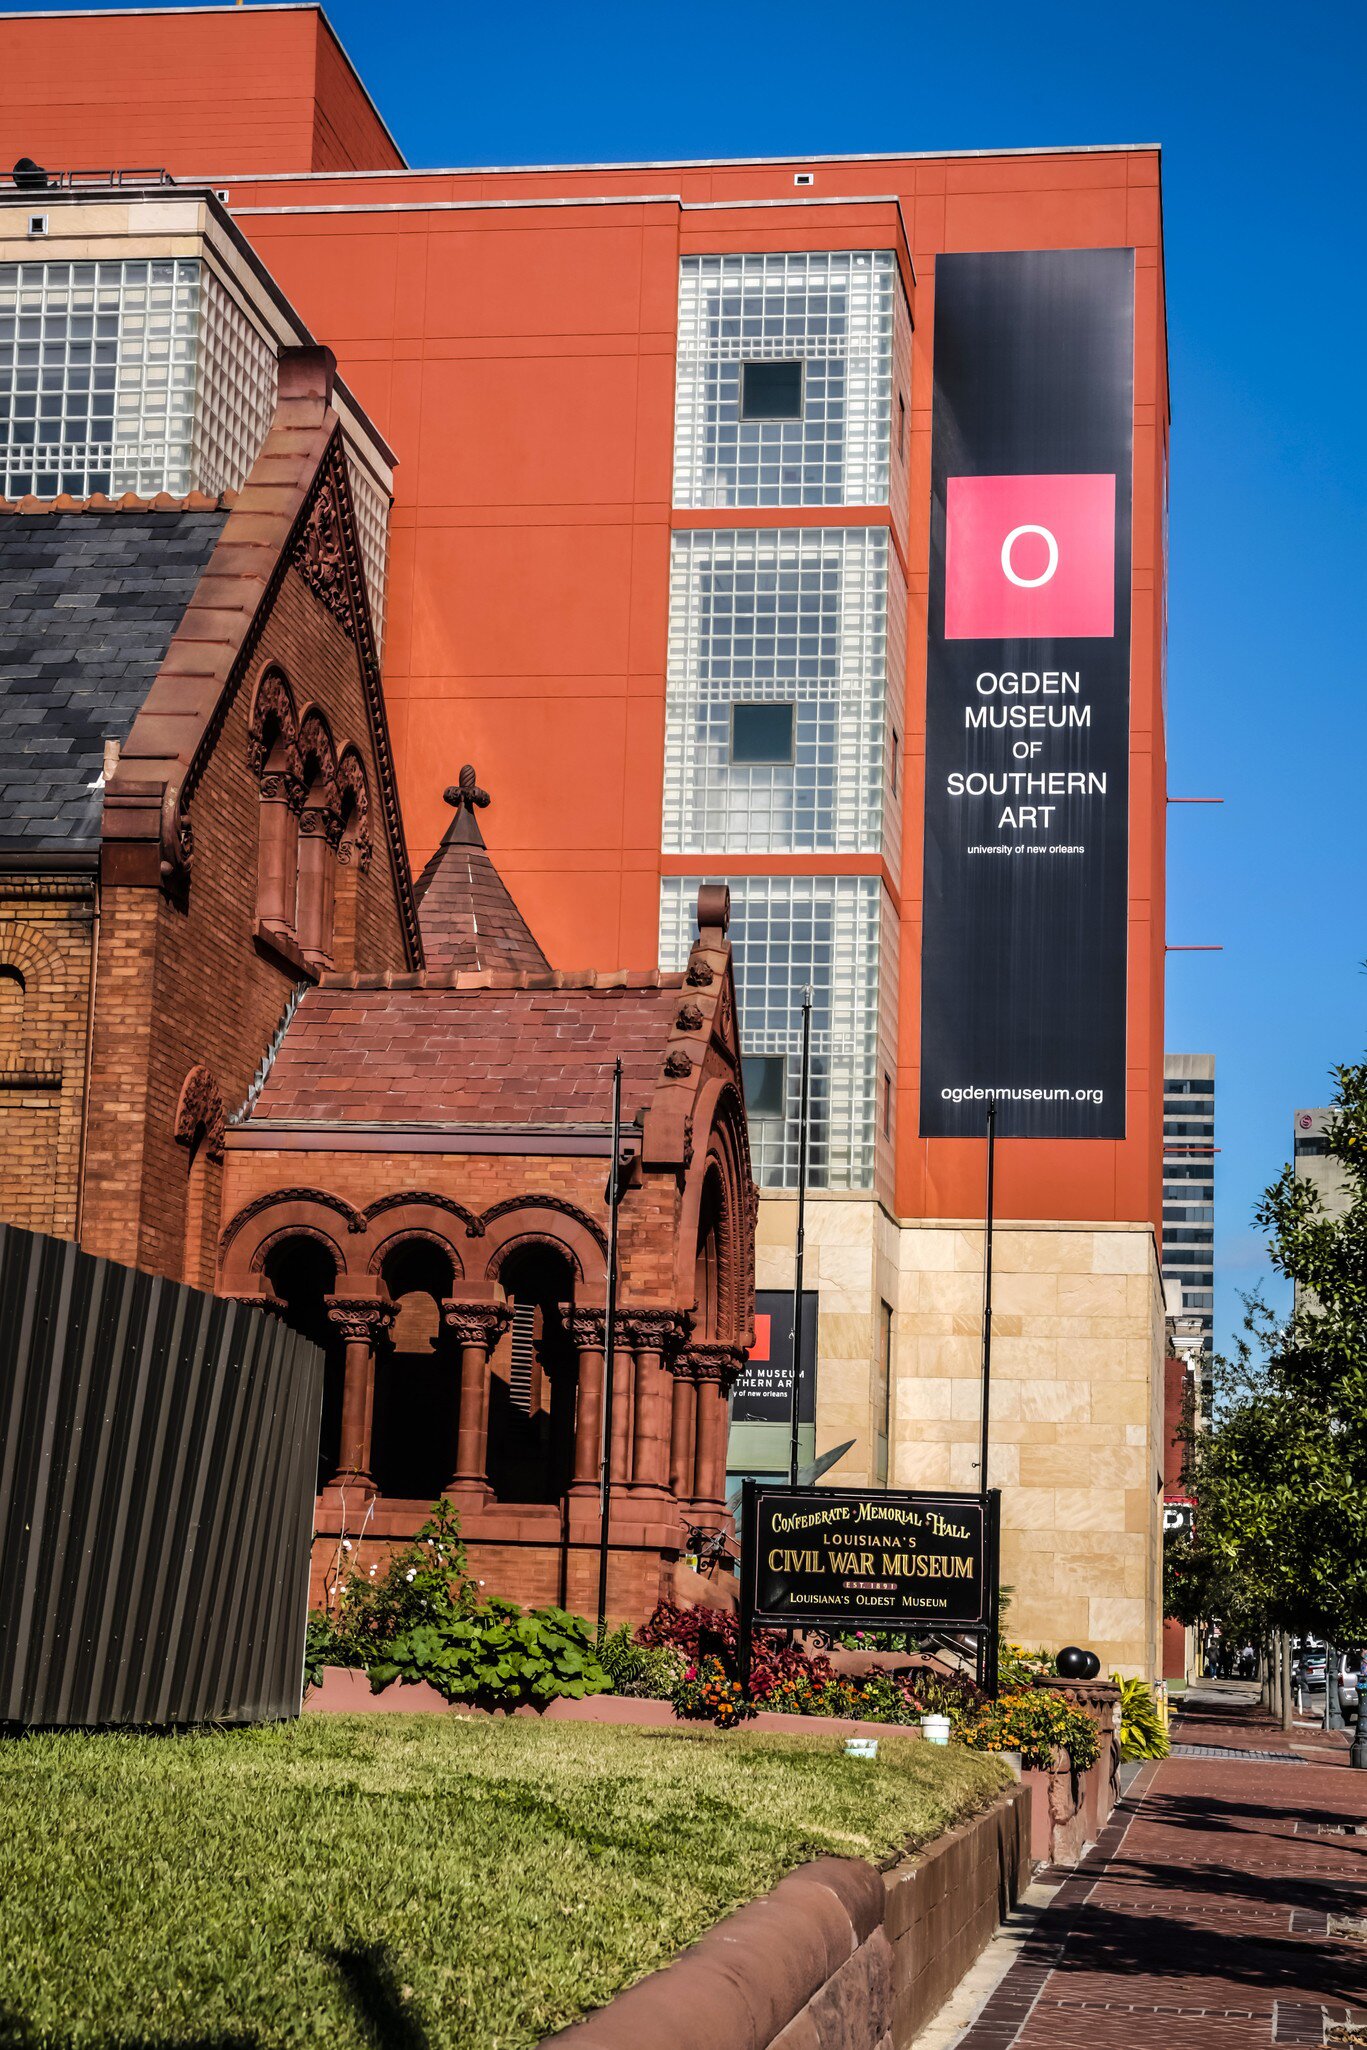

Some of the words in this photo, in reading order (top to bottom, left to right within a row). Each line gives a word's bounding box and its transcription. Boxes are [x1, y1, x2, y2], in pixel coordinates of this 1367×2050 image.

[1001, 524, 1059, 588] O
[976, 671, 1081, 695] OGDEN
[964, 705, 1092, 728] MUSEUM
[1012, 741, 1043, 759] OF
[946, 772, 1108, 796] SOUTHERN
[997, 806, 1056, 828] ART
[967, 844, 1013, 856] university
[1014, 844, 1025, 854] of
[1026, 846, 1047, 855] new
[1048, 844, 1085, 855] orleans
[940, 1086, 1104, 1104] ogdenmuseum.org
[757, 1369, 805, 1378] MUSEUM
[771, 1506, 851, 1533] CONFEDERATE
[854, 1502, 923, 1527] MEMORIAL
[926, 1512, 971, 1539] HALL
[823, 1533, 917, 1548] LOUISIANA'S
[768, 1548, 825, 1573] CIVIL
[828, 1551, 876, 1576] WAR
[881, 1553, 974, 1579] MUSEUM
[869, 1582, 895, 1590] 1891
[789, 1592, 850, 1605] LOUISIANA'S
[855, 1594, 896, 1607] OLDEST
[901, 1595, 948, 1608] MUSEUM
